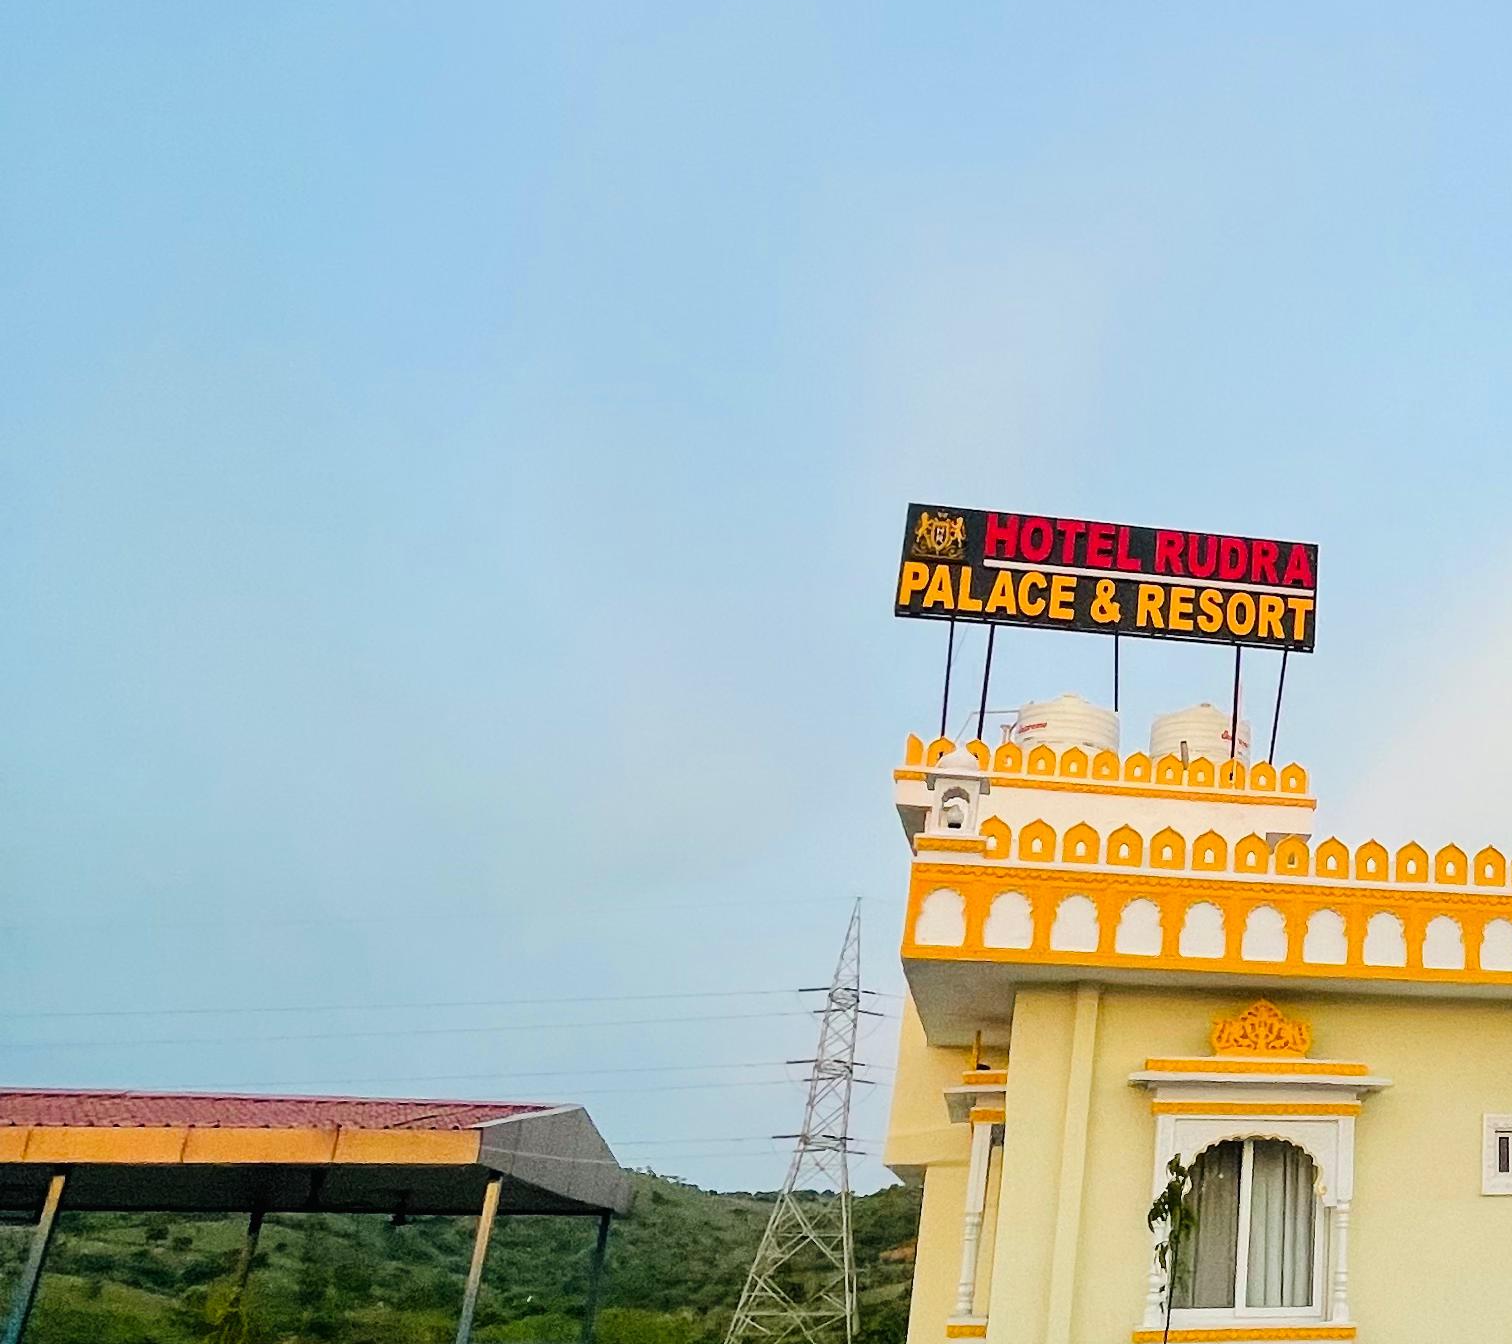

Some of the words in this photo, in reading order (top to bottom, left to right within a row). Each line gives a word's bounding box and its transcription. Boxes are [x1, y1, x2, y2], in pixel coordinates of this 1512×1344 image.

[984, 513, 1141, 571] HOTEL
[1155, 530, 1313, 587] RUDRA
[898, 561, 1077, 620] PALACE
[1090, 579, 1121, 624] &
[1136, 583, 1314, 641] RESORT
